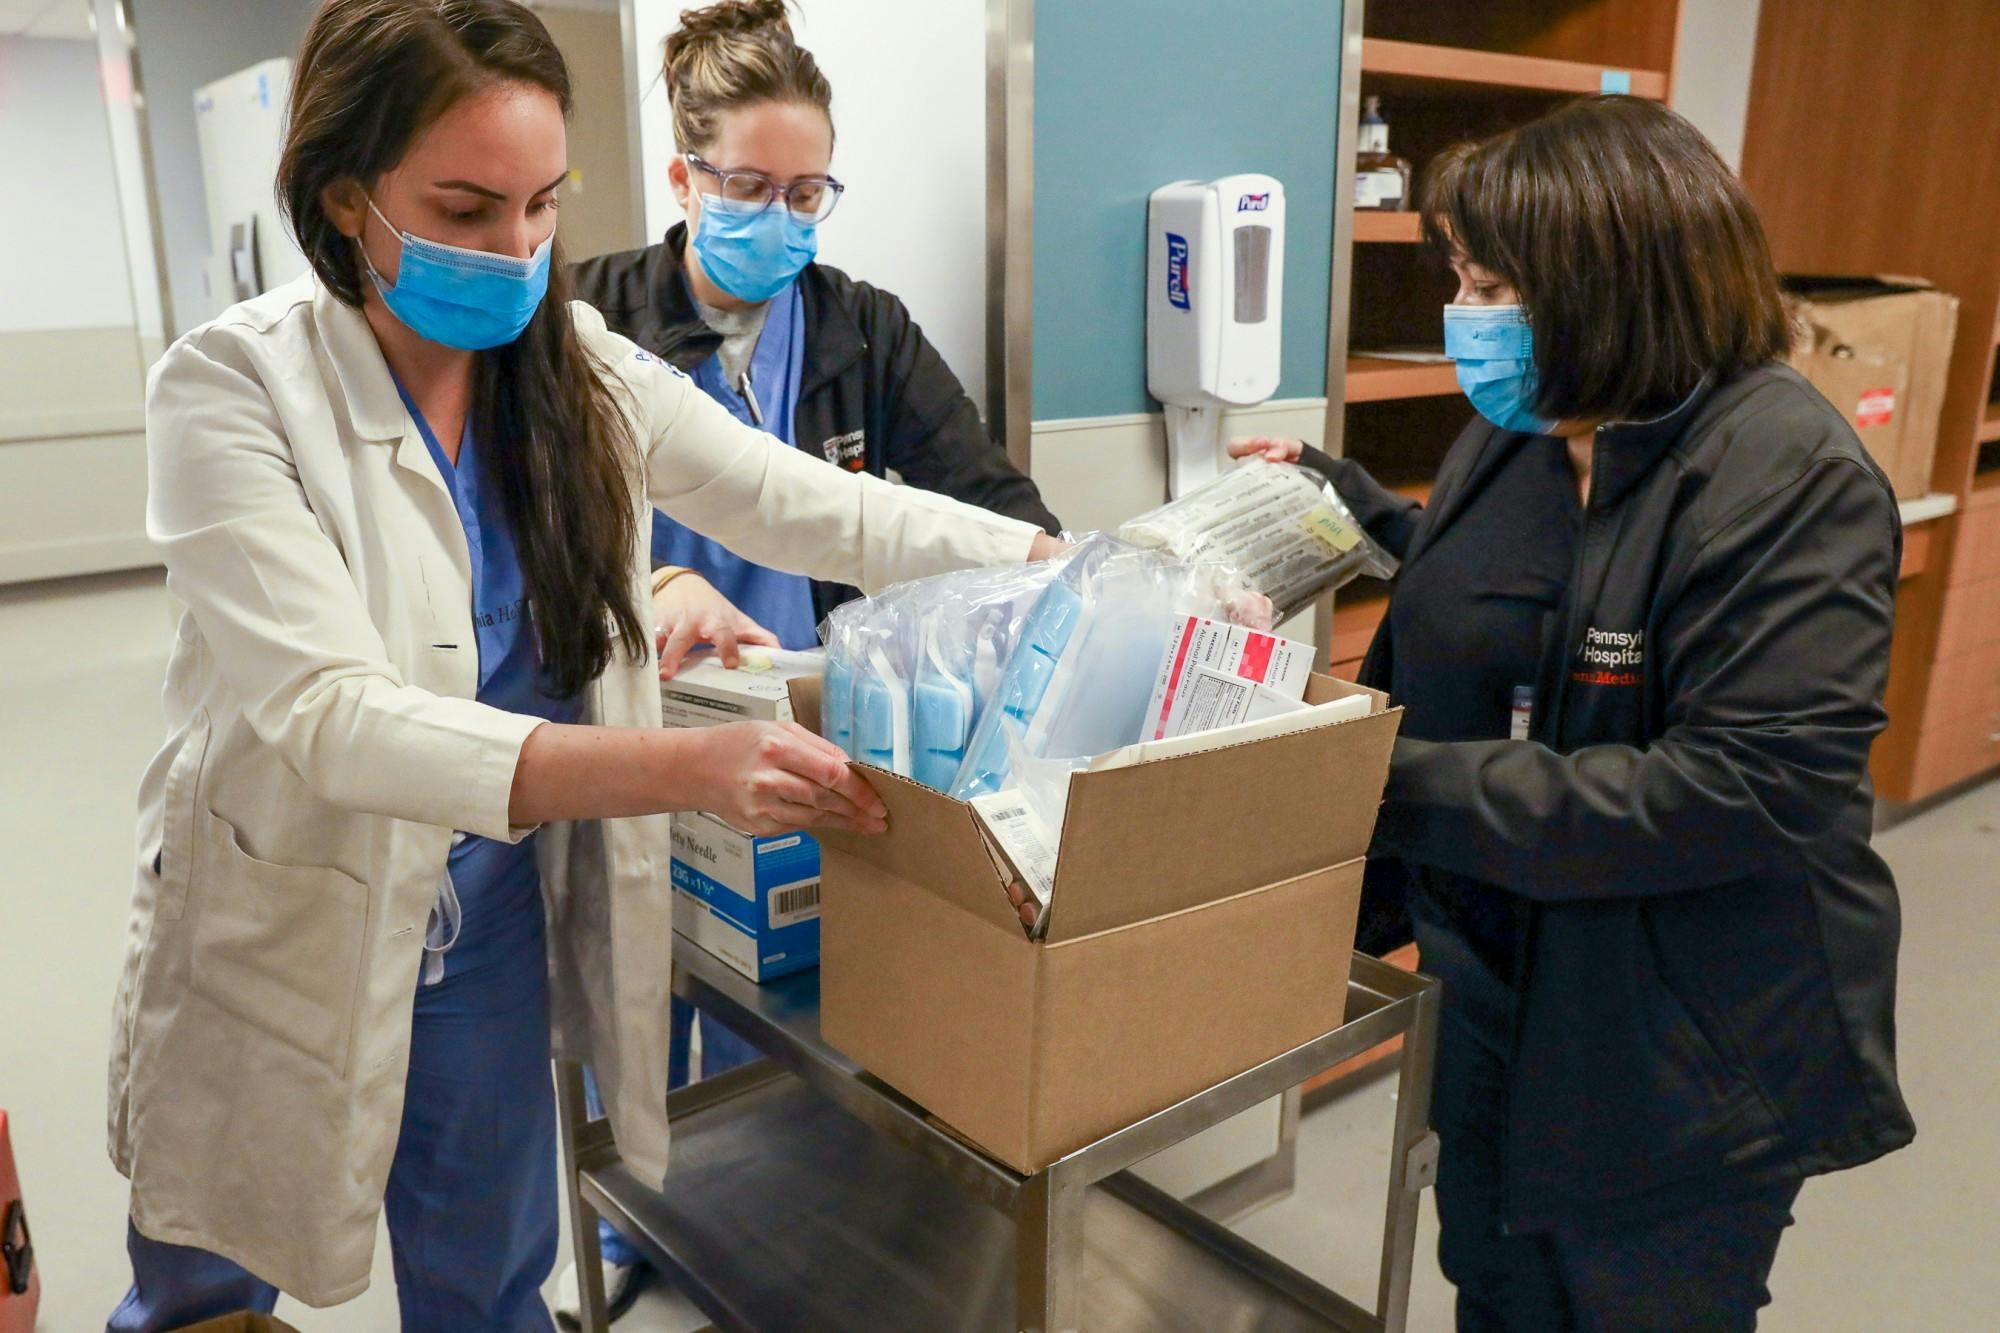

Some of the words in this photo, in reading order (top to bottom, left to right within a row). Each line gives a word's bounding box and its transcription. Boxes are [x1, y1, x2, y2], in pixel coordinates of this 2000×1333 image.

[1239, 193, 1269, 211] Purell
[1170, 241, 1187, 304] Purell
[687, 836, 718, 864] Needle
